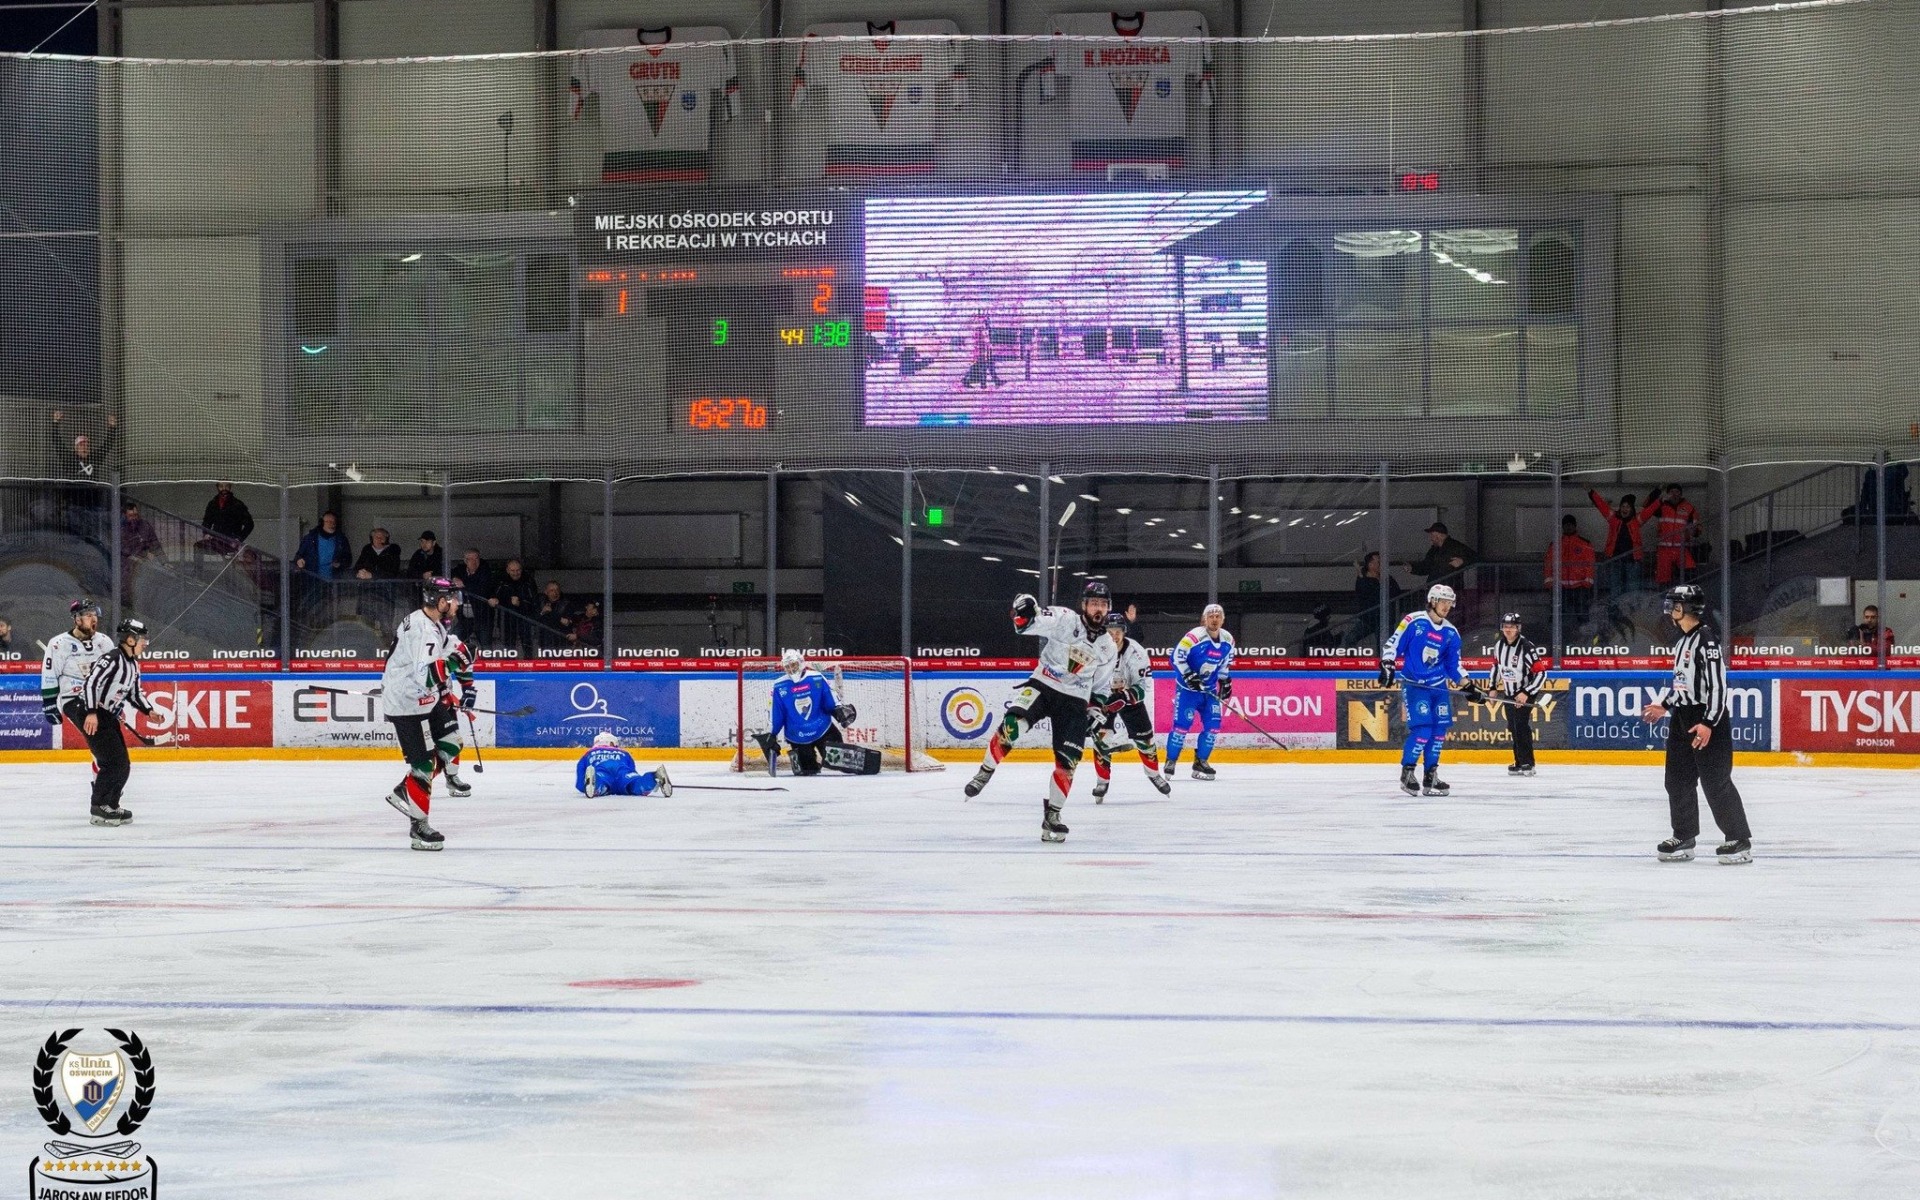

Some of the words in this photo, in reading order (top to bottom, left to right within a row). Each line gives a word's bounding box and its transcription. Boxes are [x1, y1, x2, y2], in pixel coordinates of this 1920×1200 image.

[629, 61, 681, 80] GRUTH
[595, 215, 664, 230] MIEJSKI
[668, 210, 756, 229] OŚRODEK
[760, 210, 833, 227] SPORTU
[606, 236, 611, 250] I
[616, 234, 716, 250] REKREACJI
[720, 232, 738, 247] W
[741, 230, 827, 247] TYCHACH
[617, 288, 628, 315] 1
[812, 283, 832, 314] 2
[714, 319, 728, 346] 3
[780, 328, 804, 346] 44
[212, 649, 276, 658] invenio
[295, 648, 357, 658] invenio
[426, 643, 435, 656] 7
[537, 648, 599, 658] invenio
[617, 647, 680, 657] invenio
[700, 647, 762, 657] invenio
[917, 647, 981, 657] invenio
[1309, 646, 1374, 657] invenio
[1566, 645, 1630, 656] invenio
[1734, 645, 1795, 656] invenio
[1814, 645, 1872, 656] invenio
[1890, 644, 1920, 655] inve
[1220, 695, 1322, 717] AURON
[1575, 686, 1763, 719] maxm
[1801, 690, 1920, 733] TYSKI
[536, 726, 571, 737] SANITY
[575, 726, 612, 736] SYSTEM
[616, 726, 654, 735] POLSKA
[1576, 721, 1641, 738] radość
[1856, 738, 1896, 747] SPONSOR
